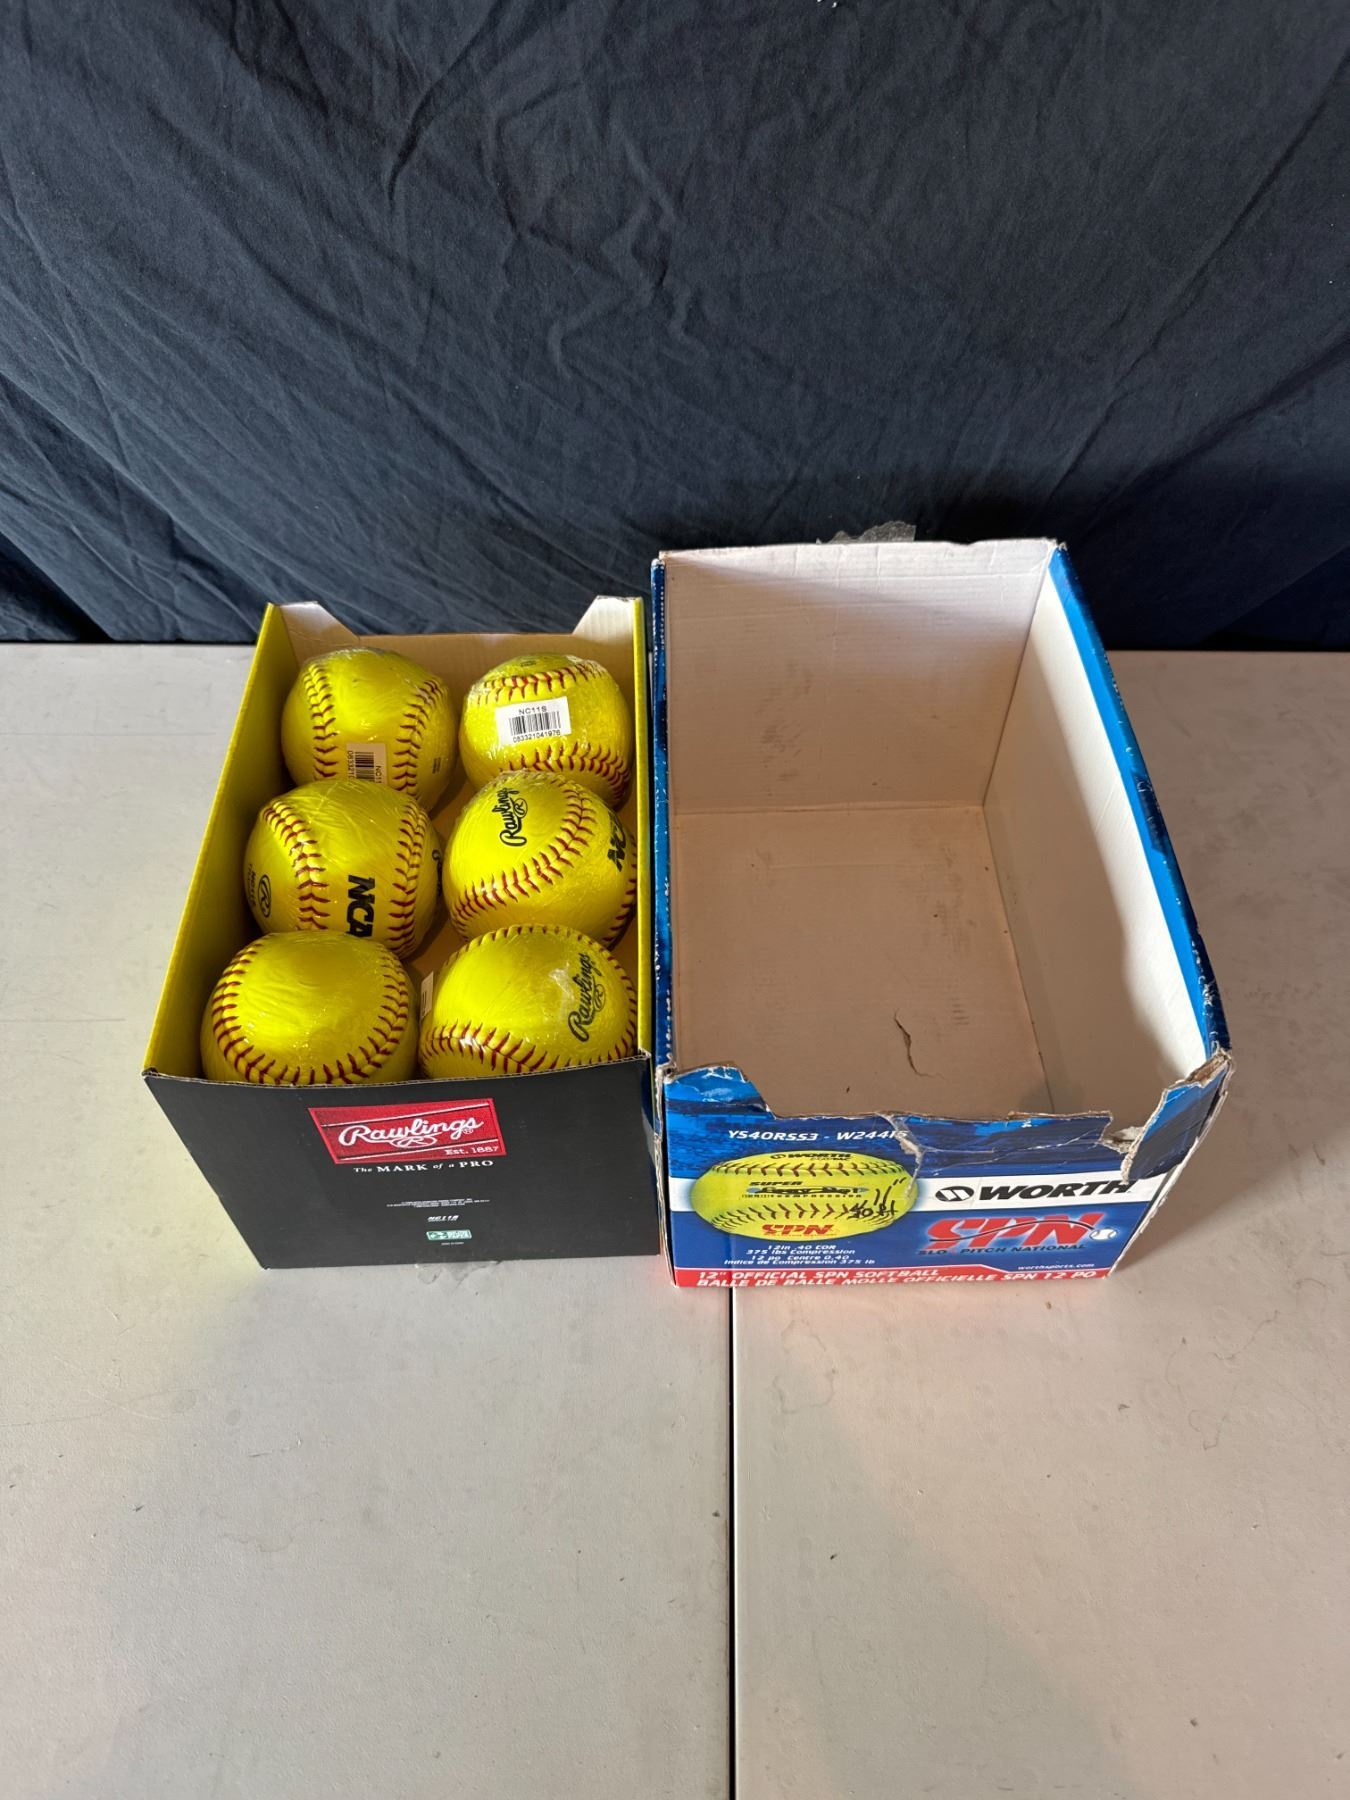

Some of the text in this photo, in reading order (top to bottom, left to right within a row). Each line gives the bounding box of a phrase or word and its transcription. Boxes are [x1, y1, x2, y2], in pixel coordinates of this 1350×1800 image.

[568, 952, 604, 1042] Rawlings
[338, 1117, 485, 1149] Rawlings
[445, 1146, 499, 1156] Est. 1887
[376, 1163, 428, 1173] MARK
[459, 1160, 494, 1168] PRO
[978, 1181, 1132, 1201] WORTH
[926, 1213, 1105, 1251] SPN
[959, 1247, 1007, 1255] PITCH
[1009, 1243, 1087, 1253] NATIONAL
[696, 1278, 748, 1287] BALLE
[754, 1278, 777, 1287] DE
[786, 1277, 834, 1286] BALLE
[841, 1276, 900, 1286] MOLLE
[904, 1274, 996, 1283] OFFICIELLE
[1003, 1271, 1038, 1281] SPN
[1072, 1270, 1097, 1279] PO
[731, 1271, 807, 1279] OFFICIAL
[815, 1271, 849, 1279] SPN
[854, 1269, 939, 1279] SOFTBALL
